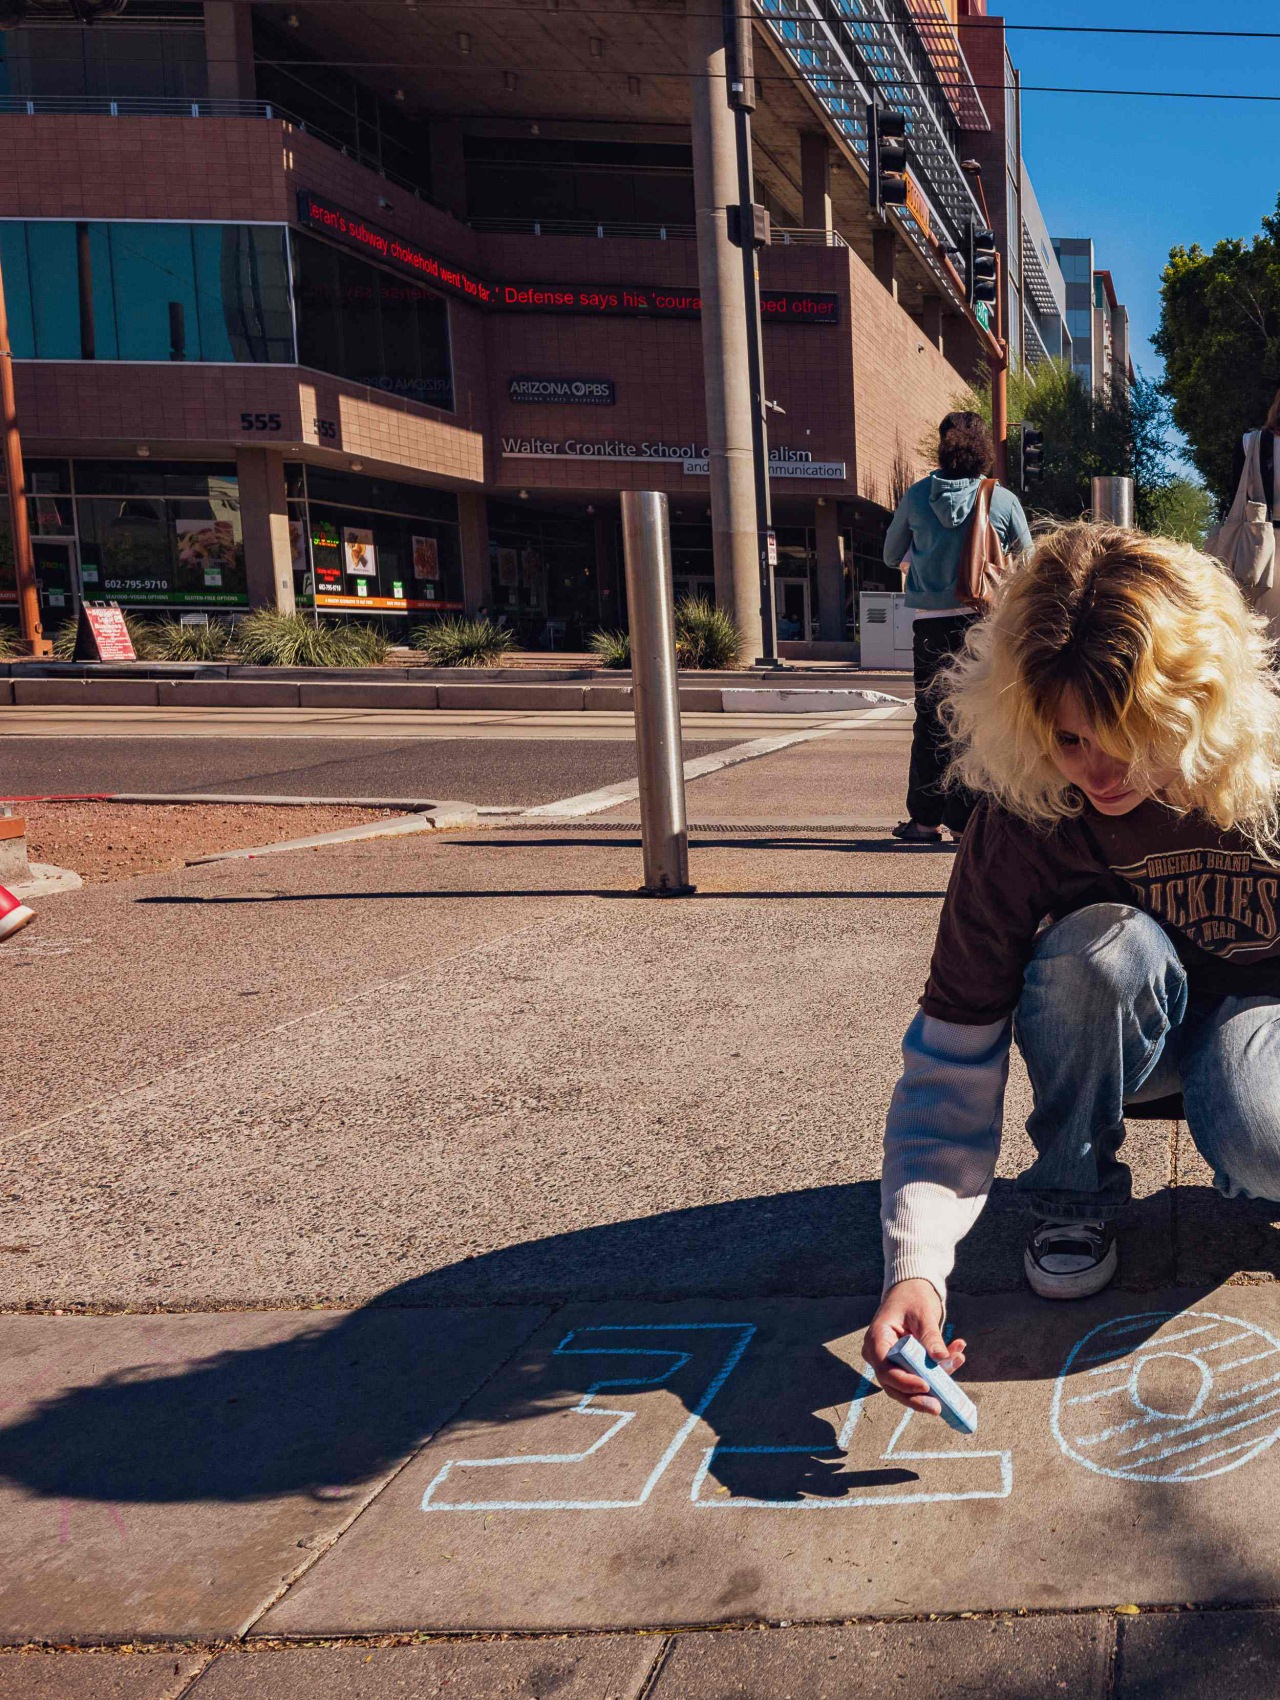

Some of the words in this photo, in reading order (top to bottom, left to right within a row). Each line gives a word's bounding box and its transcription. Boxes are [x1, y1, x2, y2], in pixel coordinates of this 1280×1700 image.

[349, 221, 389, 256] subway
[390, 241, 439, 277] chokehold
[440, 264, 461, 287] went
[503, 286, 574, 306] Defense
[580, 292, 618, 311] says
[622, 291, 647, 307] his
[652, 292, 702, 310] 'coura
[509, 381, 571, 396] ARIZONA
[585, 383, 609, 397] PBS
[241, 413, 282, 431] 555
[313, 417, 336, 439] 555
[502, 438, 560, 455] Walter
[565, 440, 637, 457] Cronkite
[641, 442, 697, 458] School
[701, 447, 711, 459] o
[769, 446, 812, 462] alism
[687, 461, 710, 472] and
[104, 579, 168, 590] 602-795-9710
[1147, 853, 1203, 878] ORIGINAL
[1206, 853, 1250, 873] BRAND
[1137, 873, 1279, 939] ICKIES
[1201, 921, 1237, 942] WEAR
